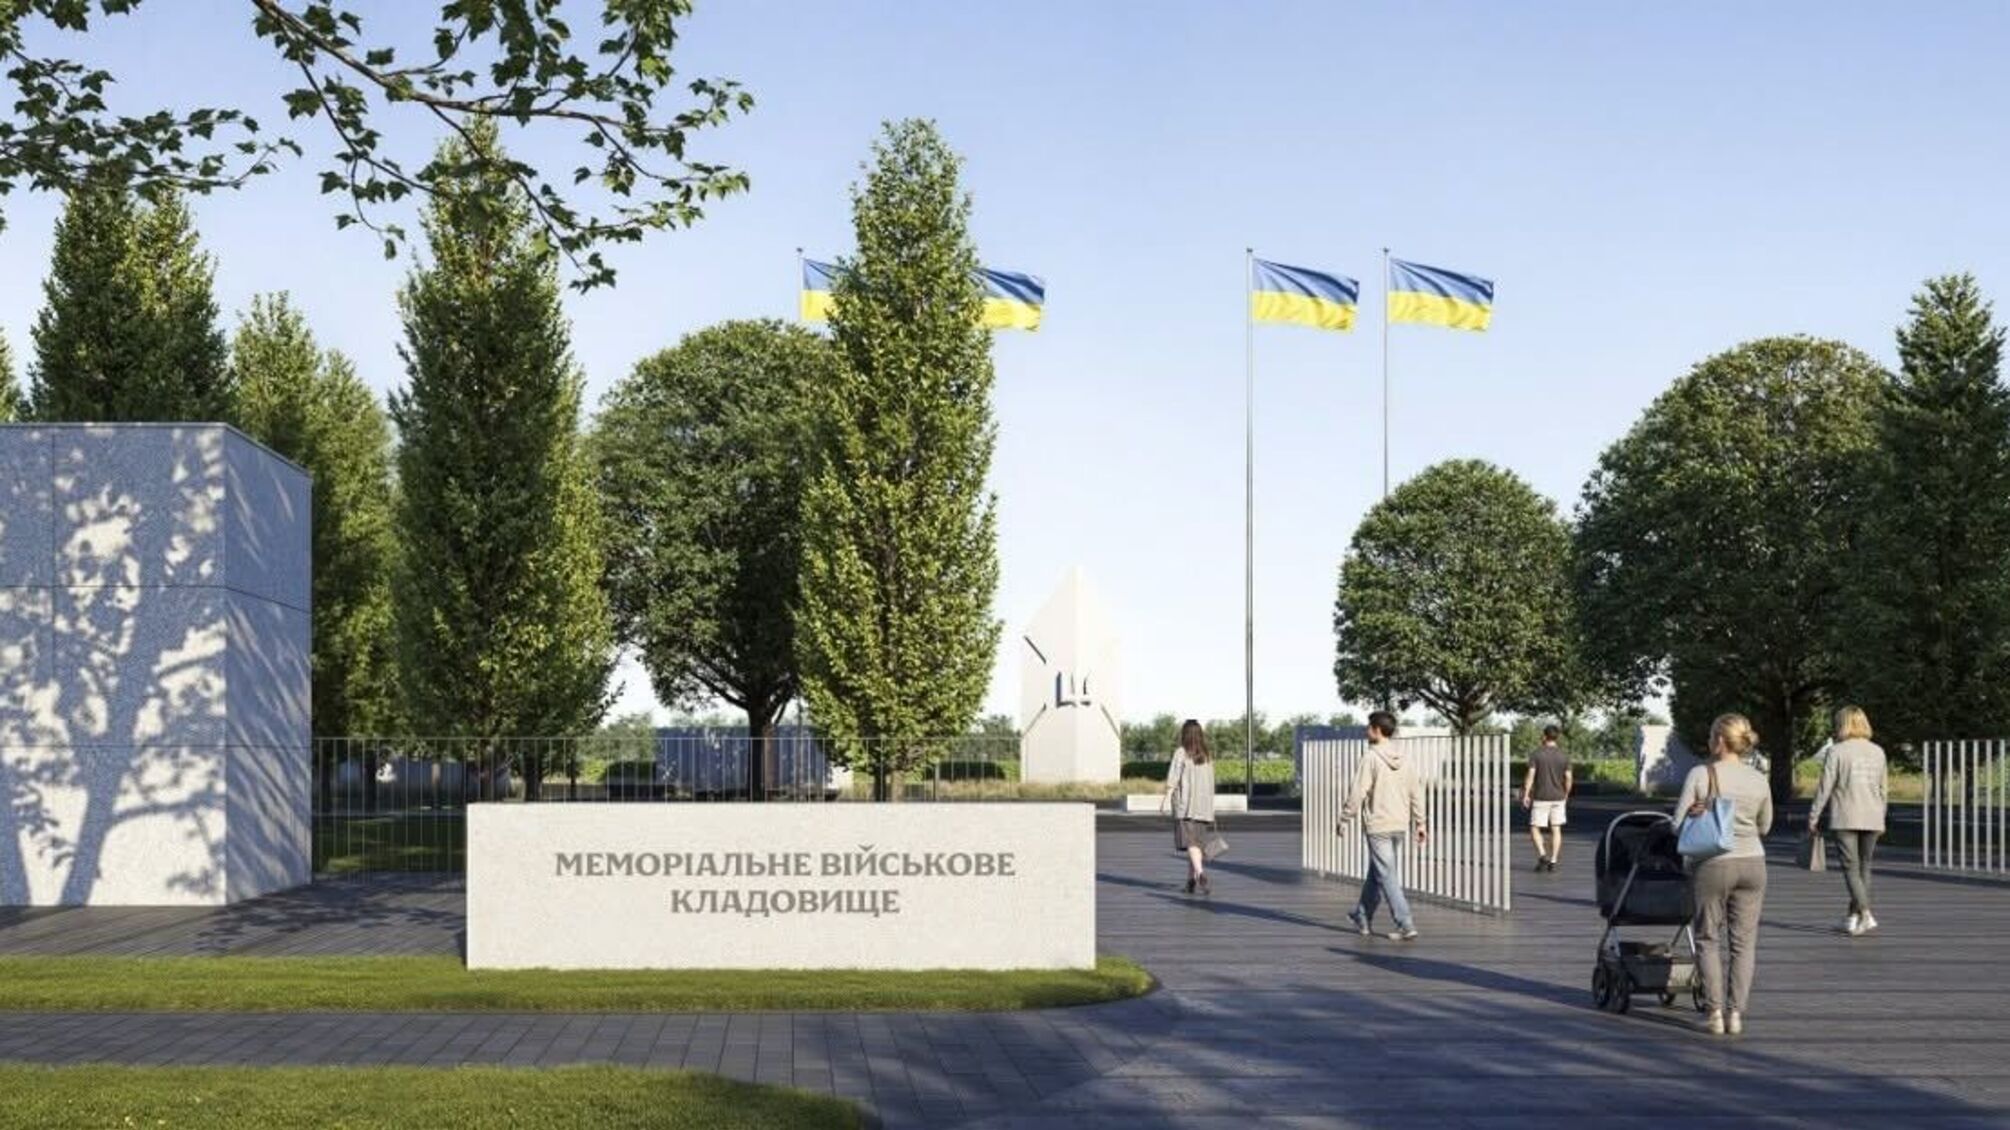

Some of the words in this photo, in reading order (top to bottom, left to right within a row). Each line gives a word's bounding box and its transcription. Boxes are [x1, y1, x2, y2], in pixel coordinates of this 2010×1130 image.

[555, 852, 811, 876] МЕМОРІАЛЬНЕ
[821, 846, 1015, 876] ВІЙСЬКОВЕ
[672, 890, 899, 918] КЛАДОВИЩЕ
